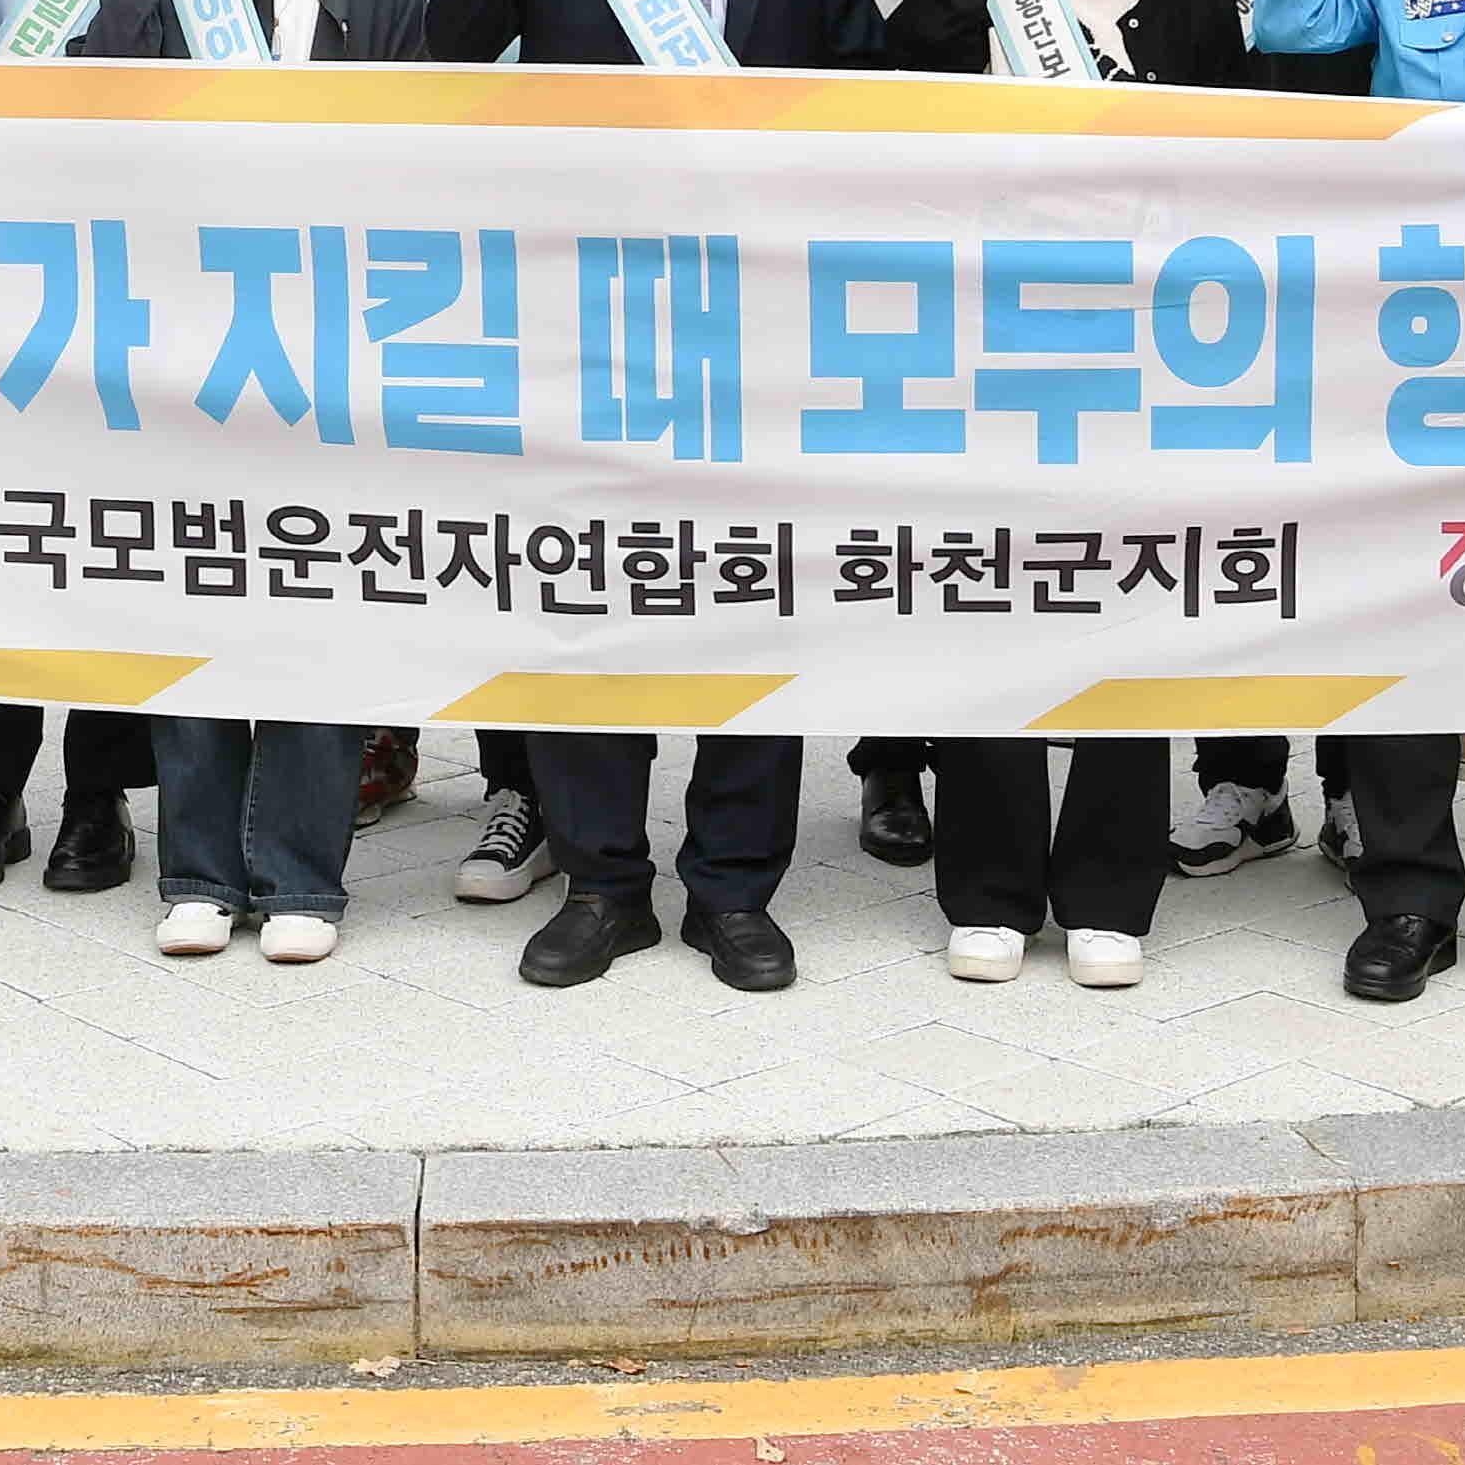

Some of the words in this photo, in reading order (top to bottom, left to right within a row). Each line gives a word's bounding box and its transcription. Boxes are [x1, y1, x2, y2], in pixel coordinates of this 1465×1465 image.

[193, 225, 524, 457] 지킬
[577, 233, 743, 463] 때
[800, 234, 1316, 465] 모두의
[832, 520, 1300, 621] 화천군지회
